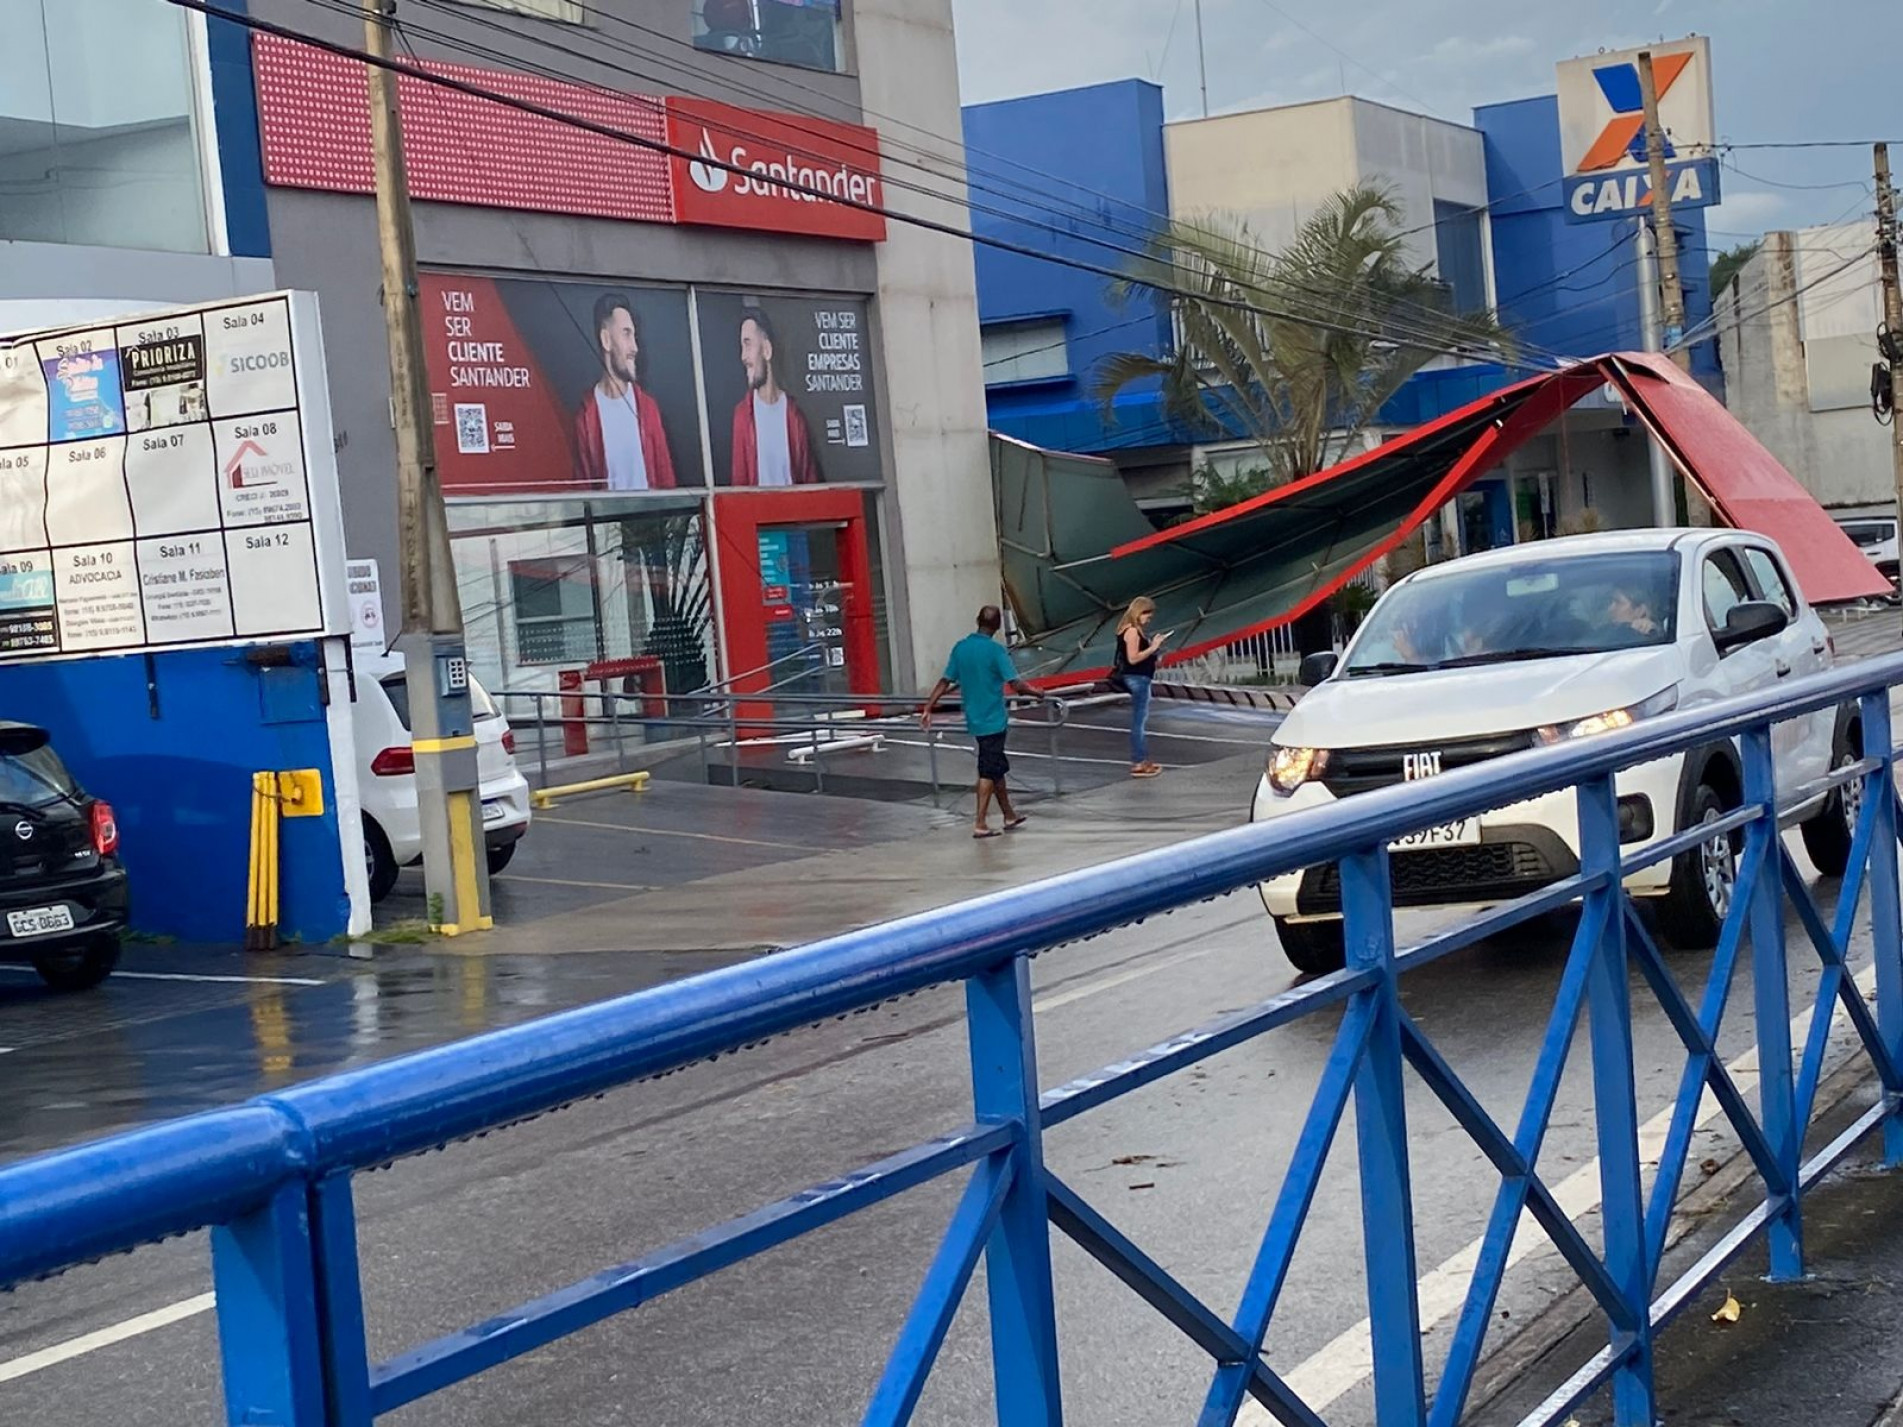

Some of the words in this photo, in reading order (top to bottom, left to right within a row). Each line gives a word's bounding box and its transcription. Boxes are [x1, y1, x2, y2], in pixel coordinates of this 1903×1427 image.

[730, 145, 876, 206] Santander
[441, 290, 474, 312] VEM
[223, 317, 248, 330] Sala
[250, 313, 265, 325] 04
[446, 316, 473, 337] SER
[815, 311, 837, 329] VEM
[838, 312, 856, 329] SER
[138, 331, 164, 344] Sala
[166, 326, 180, 340] 03
[818, 332, 859, 350] CLIENTE
[56, 344, 79, 358] Sala
[80, 340, 93, 352] 02
[131, 342, 196, 370] PRIORIZA
[447, 341, 505, 363] CLIENTE
[230, 351, 290, 373] SICOOB
[808, 352, 861, 371] EMPRESAS
[450, 366, 530, 388] SANTANDER
[805, 374, 863, 392] SANTANDER
[234, 425, 260, 439] Sala
[262, 422, 278, 435] 08
[143, 437, 168, 451] Sala
[170, 434, 184, 447] 07
[15, 456, 30, 468] 05
[68, 450, 94, 464] Sala
[94, 447, 107, 460] 06
[246, 535, 272, 550] Sala
[272, 533, 289, 547] 12
[73, 554, 96, 568] Sala
[100, 552, 113, 565] 10
[159, 545, 186, 559] Sala
[189, 543, 202, 555] 11
[0, 563, 18, 575] ala
[20, 560, 34, 573] 09
[1403, 751, 1442, 782] FIAT
